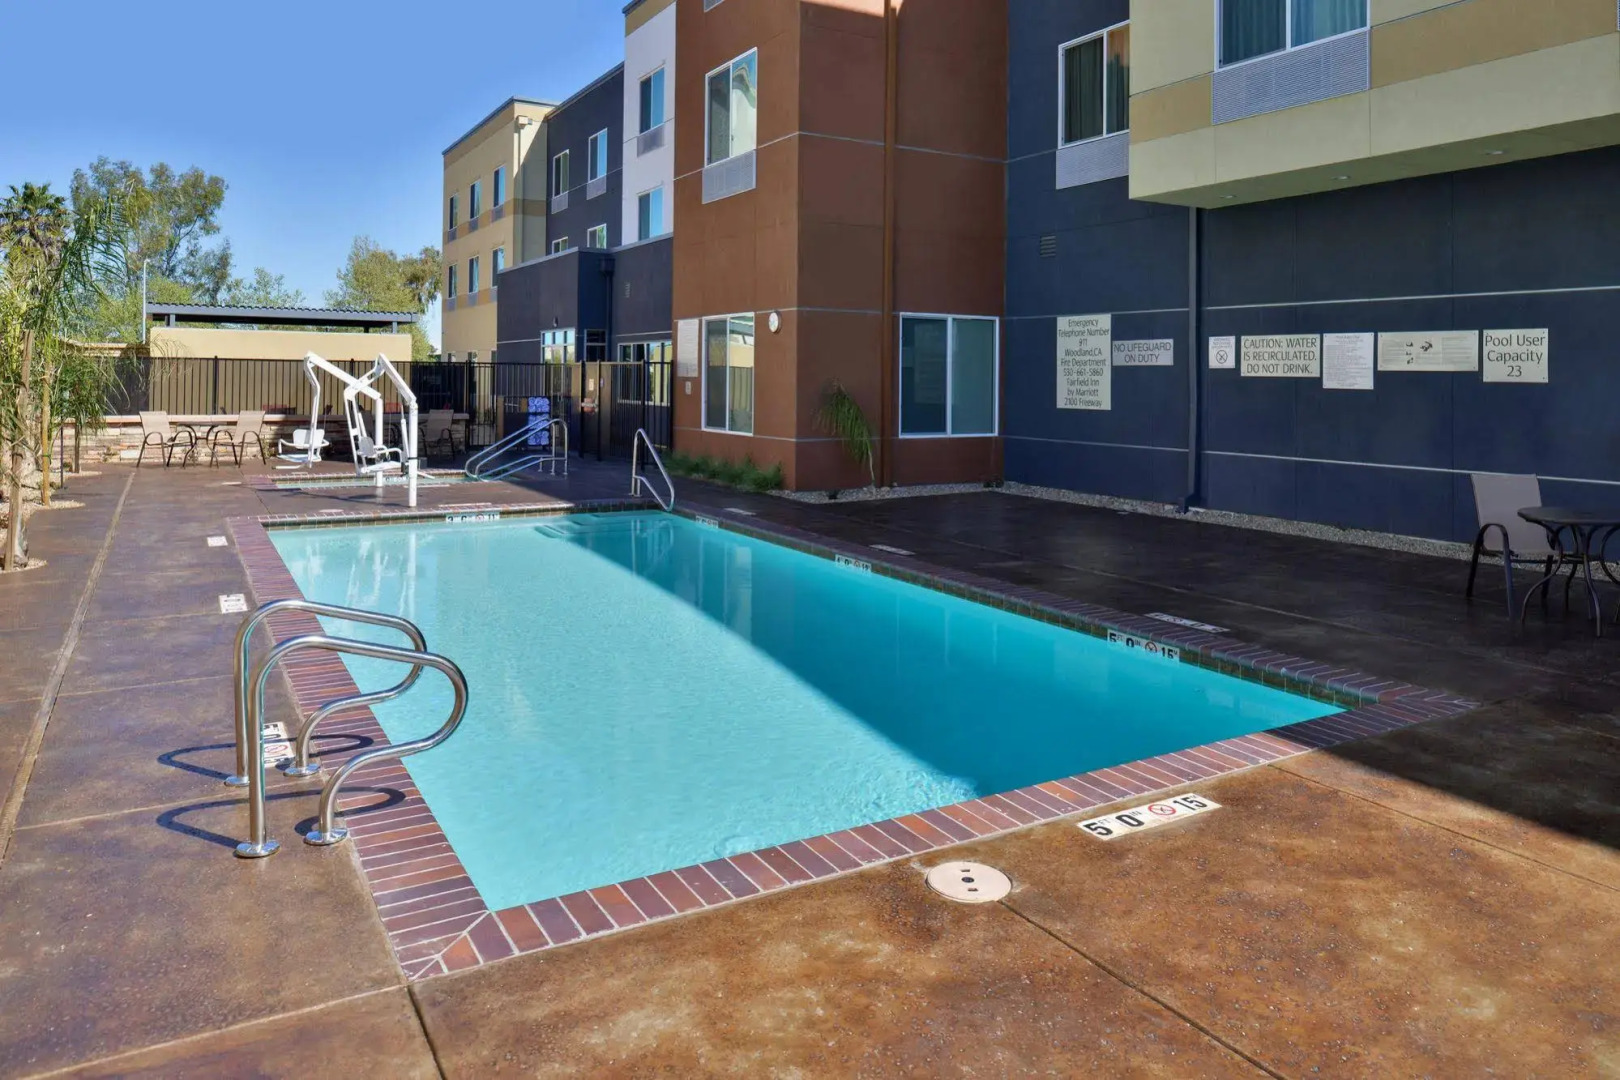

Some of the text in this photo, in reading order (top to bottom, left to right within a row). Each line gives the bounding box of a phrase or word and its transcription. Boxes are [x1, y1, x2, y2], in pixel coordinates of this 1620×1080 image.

[1068, 319, 1098, 328] Emergency
[1059, 328, 1109, 338] Telephone Number
[1244, 338, 1283, 349] CAUTION:
[1286, 338, 1316, 348] WATER
[1486, 334, 1546, 346] Pool User
[1114, 342, 1172, 352] NO LIFEGUARD
[1124, 354, 1160, 363] ON DUTY
[1244, 350, 1316, 361] IS RECIRCULATED.
[1487, 349, 1543, 364] Capacity
[1072, 358, 1106, 367] Department
[1246, 364, 1312, 374] DO NOT DRINK.
[1507, 366, 1522, 378] 23
[1076, 388, 1098, 396] Marriott
[1083, 822, 1113, 836] 5
[1115, 814, 1144, 827] 0
